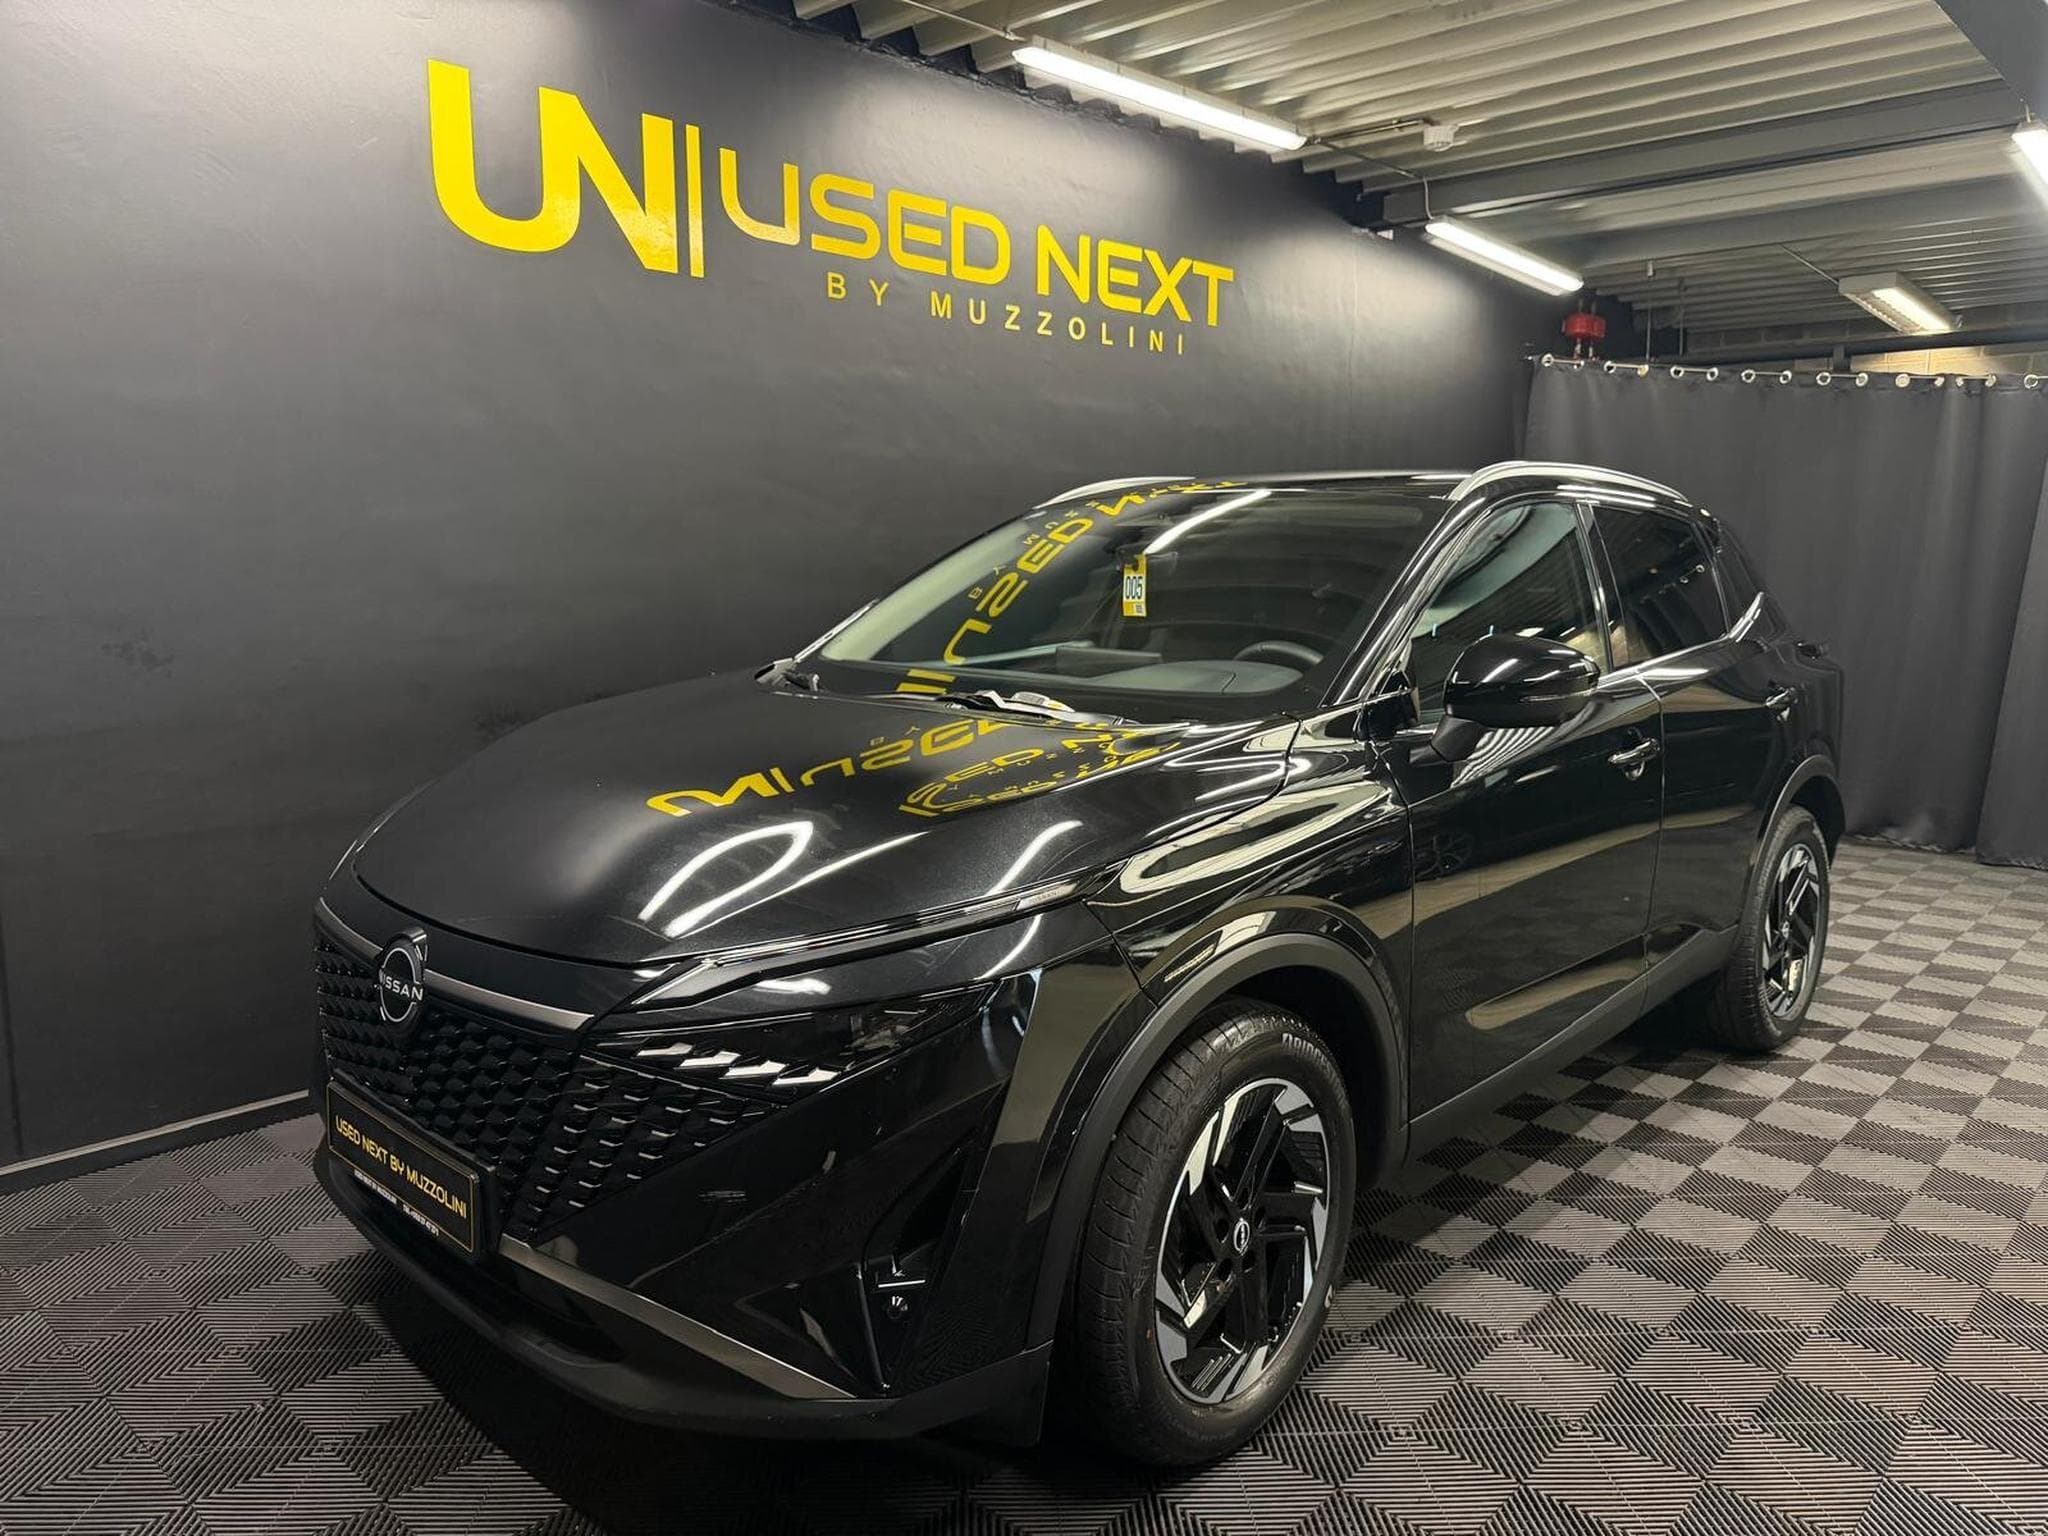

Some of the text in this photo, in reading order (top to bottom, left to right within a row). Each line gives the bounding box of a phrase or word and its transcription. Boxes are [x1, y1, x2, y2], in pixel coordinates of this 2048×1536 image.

[719, 147, 1236, 328] USED NEXT
[826, 270, 1187, 355] BY MUZZOLINI
[1125, 575, 1143, 600] 005
[335, 1115, 361, 1146] USED
[361, 1135, 388, 1165] NEXT
[389, 1154, 405, 1175] BY
[406, 1165, 467, 1219] MUZZOLINI
